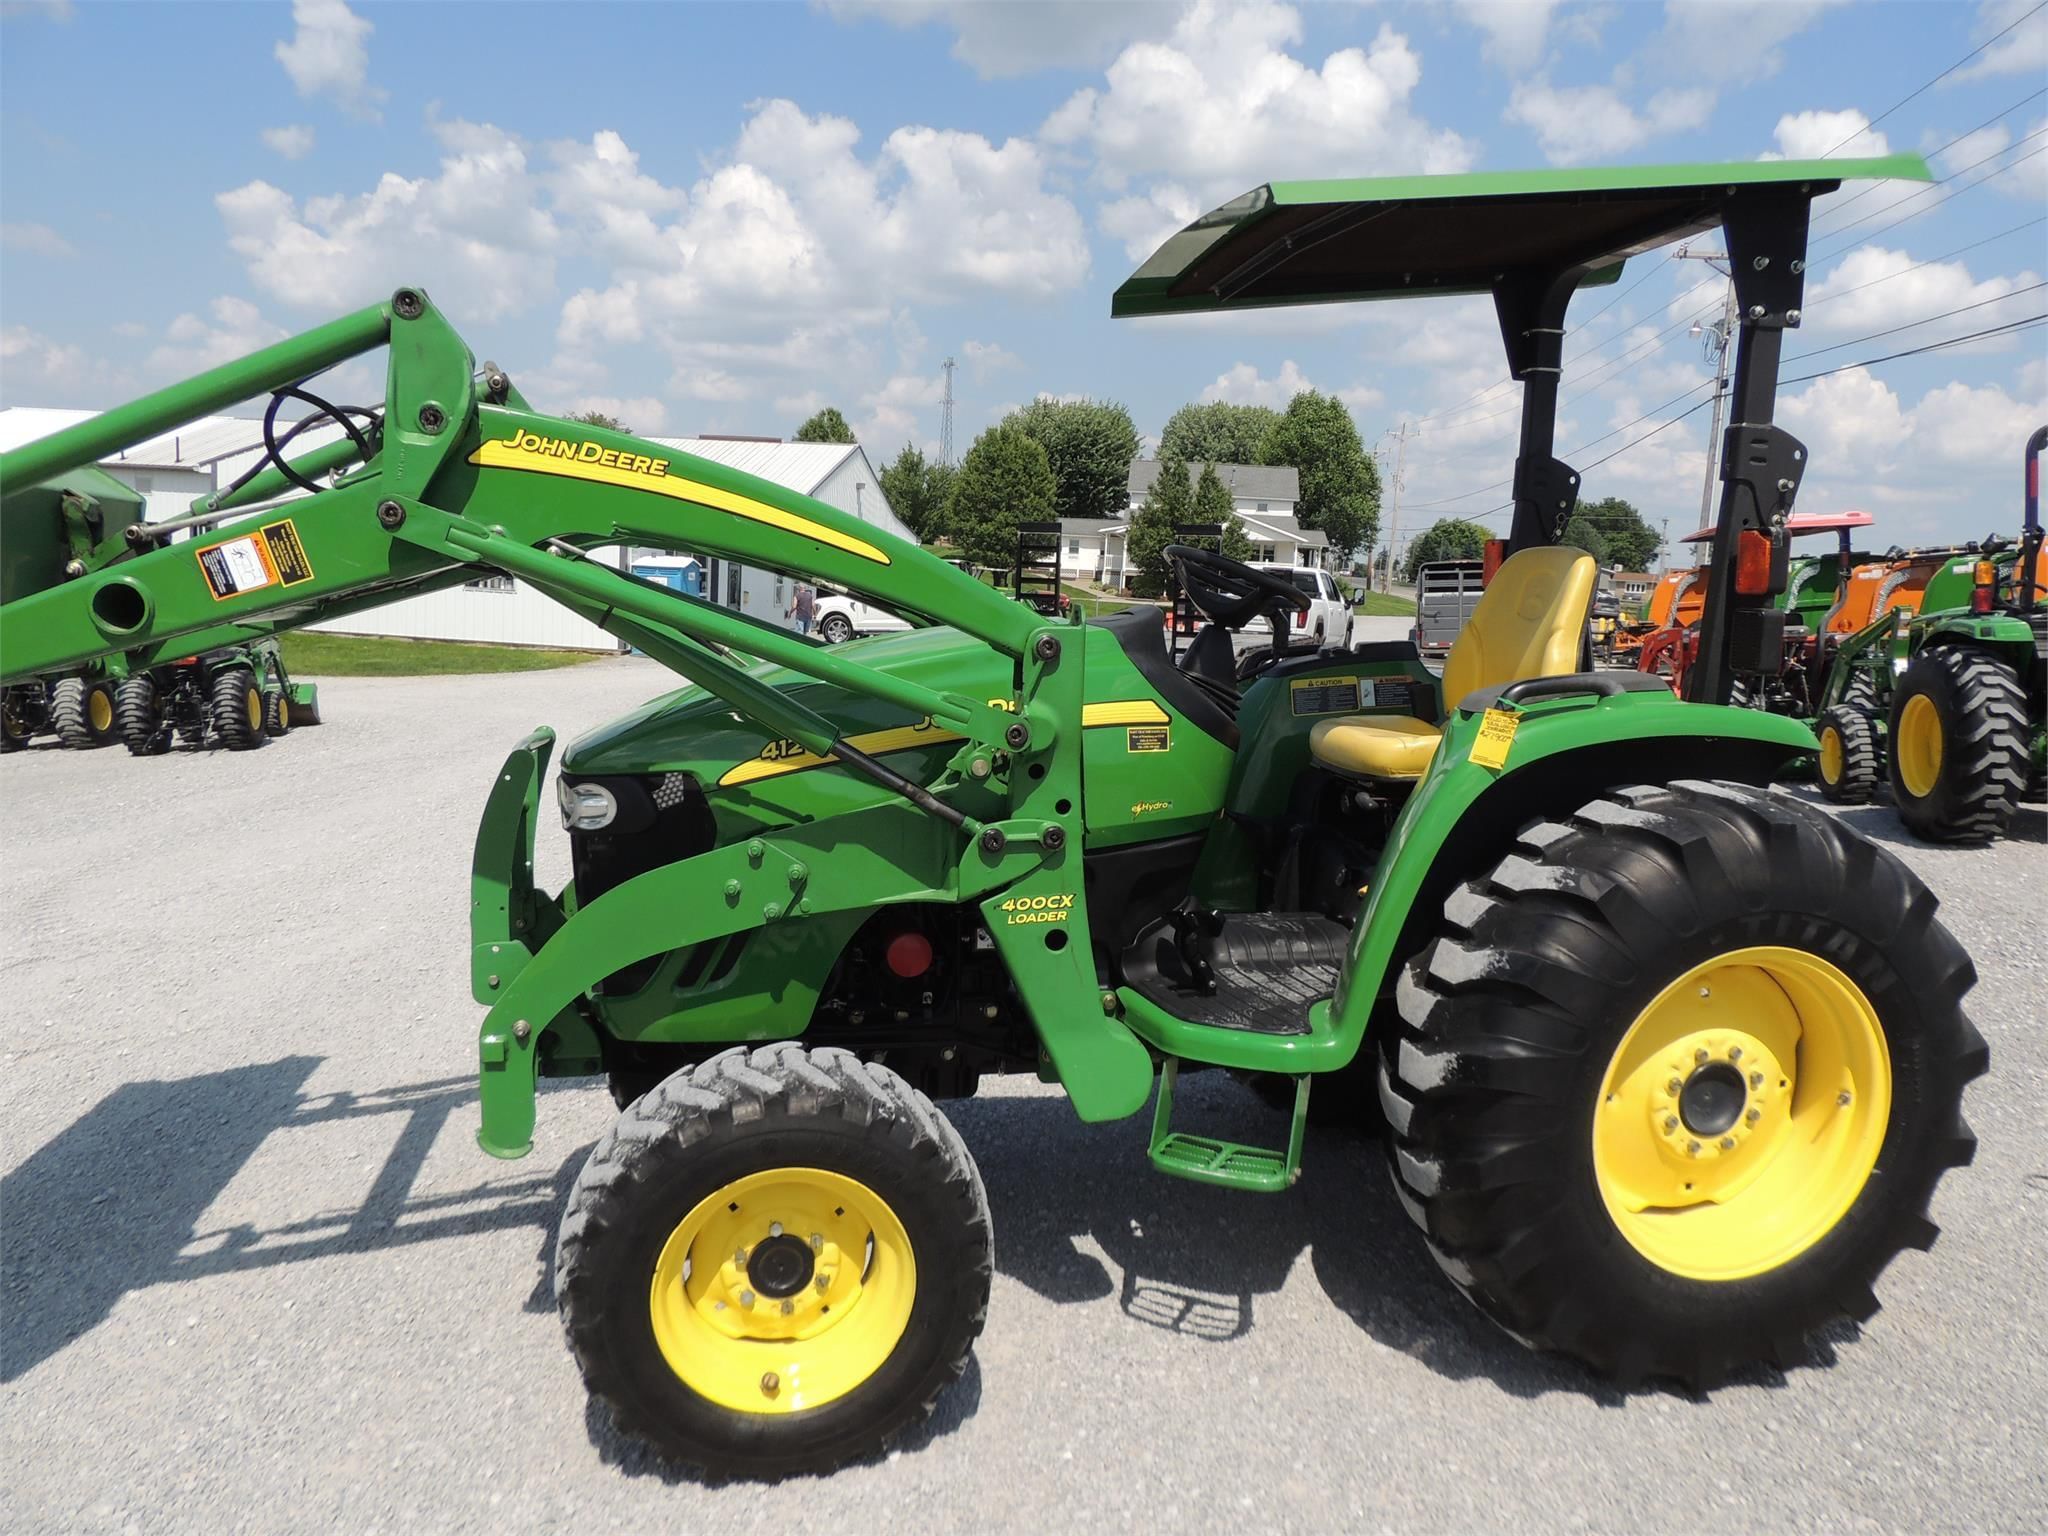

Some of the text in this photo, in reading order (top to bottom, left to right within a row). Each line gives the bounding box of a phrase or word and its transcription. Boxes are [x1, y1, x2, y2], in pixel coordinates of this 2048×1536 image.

[502, 429, 670, 477] JOHN DEERE
[1315, 679, 1343, 687] CAUTION
[761, 739, 805, 760] 412
[1001, 894, 1075, 912] 400CX
[1008, 911, 1067, 925] LOADER
[1739, 913, 1900, 994] TITAN
